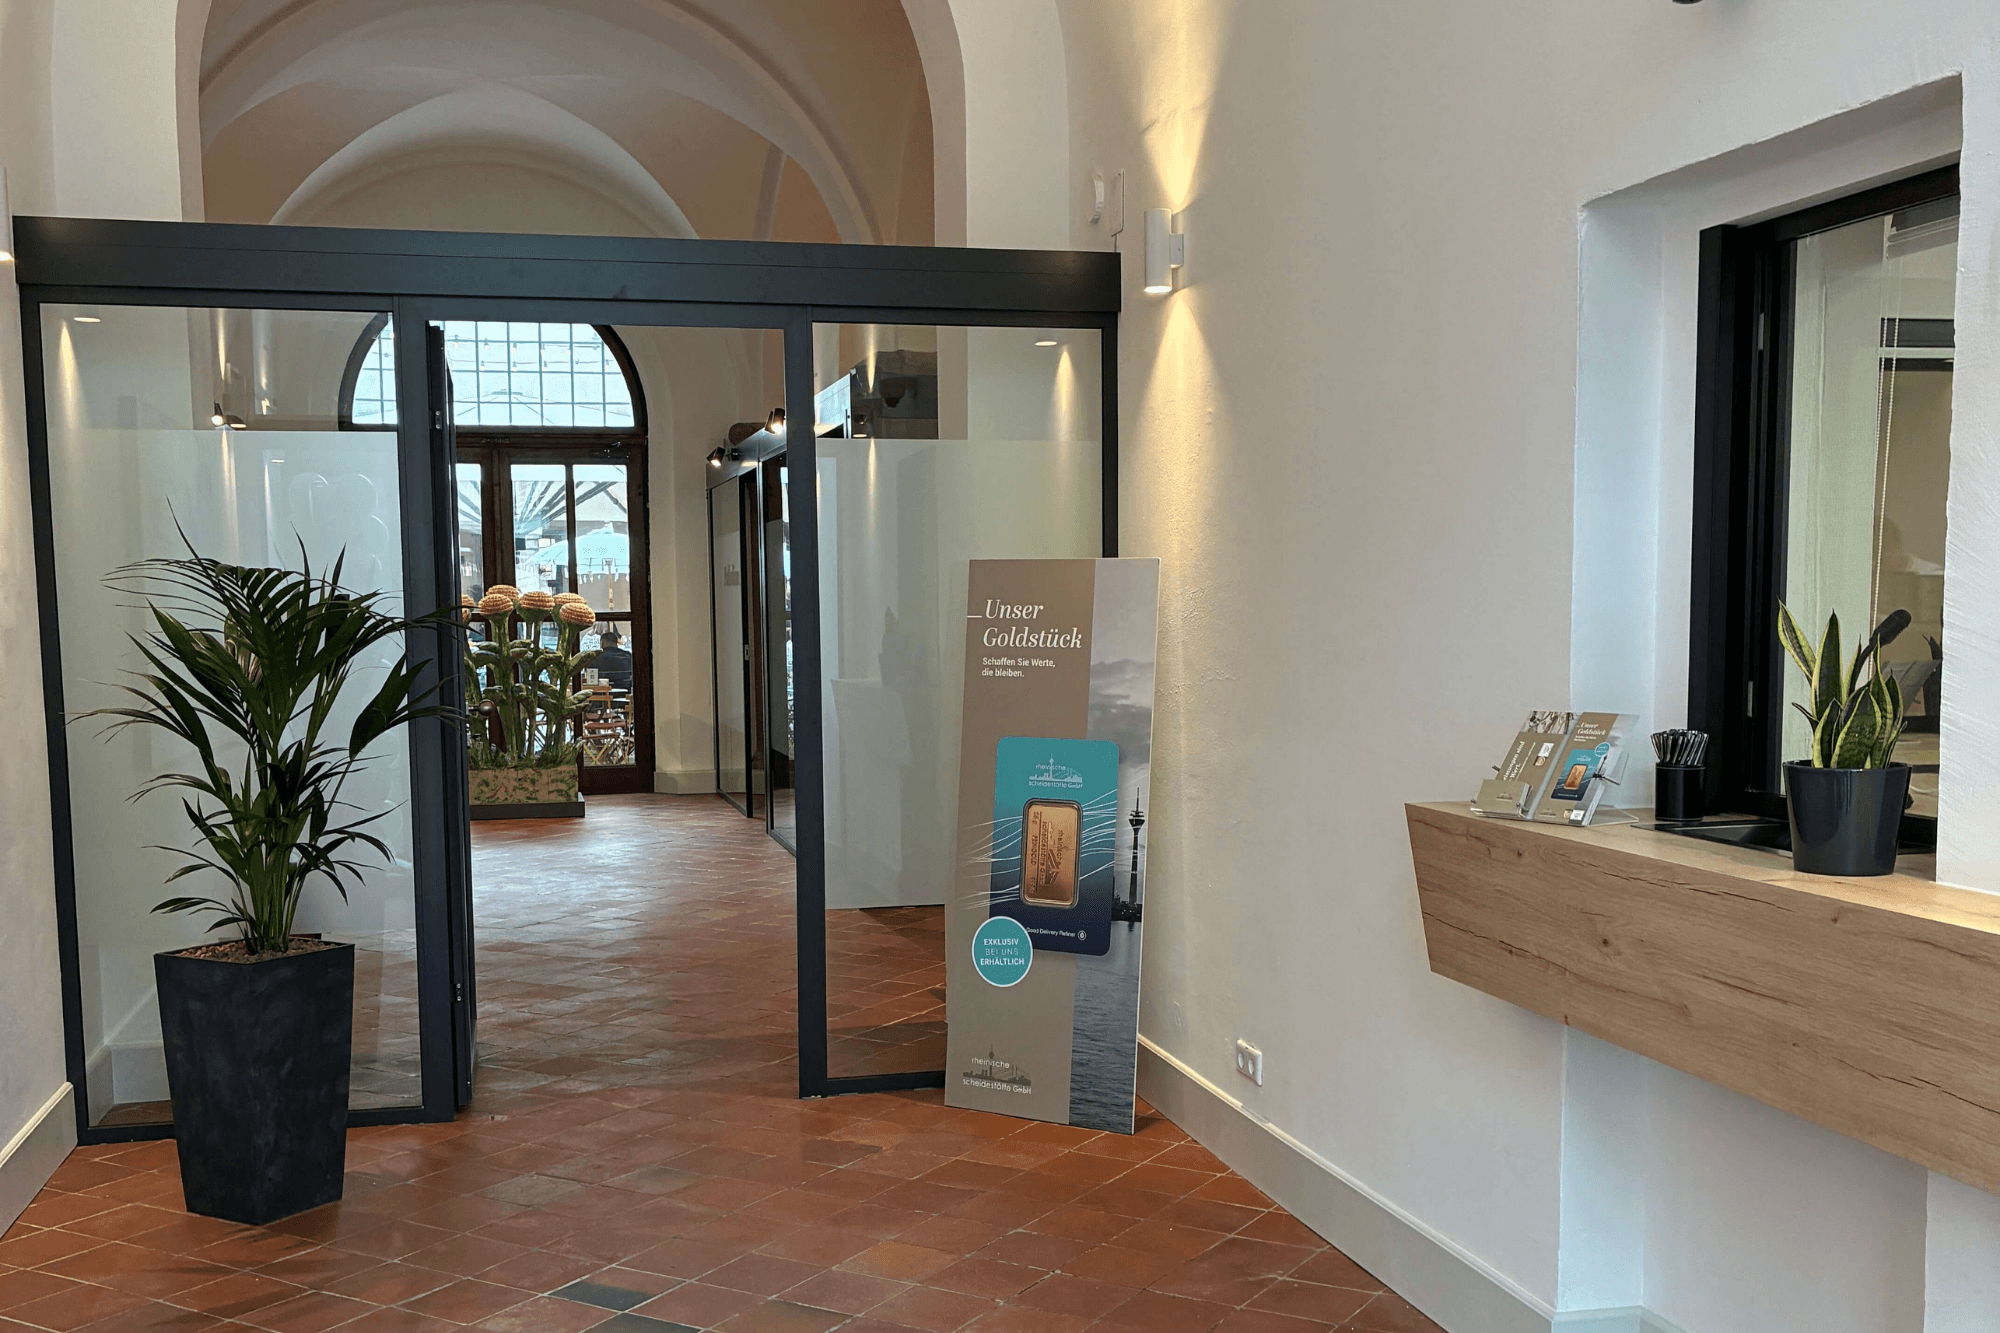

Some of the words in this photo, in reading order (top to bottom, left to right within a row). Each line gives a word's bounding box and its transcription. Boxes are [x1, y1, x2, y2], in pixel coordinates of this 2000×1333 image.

[985, 599, 1044, 619] Unser
[983, 626, 1082, 648] Goldstück
[982, 657, 1016, 666] Schaffen
[1017, 657, 1030, 666] Sie
[1031, 658, 1056, 668] Werte,
[981, 667, 994, 676] die
[994, 668, 1025, 677] bleiben.
[983, 938, 1019, 946] EXKLUSIV
[985, 948, 999, 956] BEI
[1001, 948, 1019, 956] UNS
[980, 957, 1025, 966] ERHÄLTLICH
[971, 1057, 1010, 1069] rheinische
[1012, 1085, 1032, 1095] GmbH
